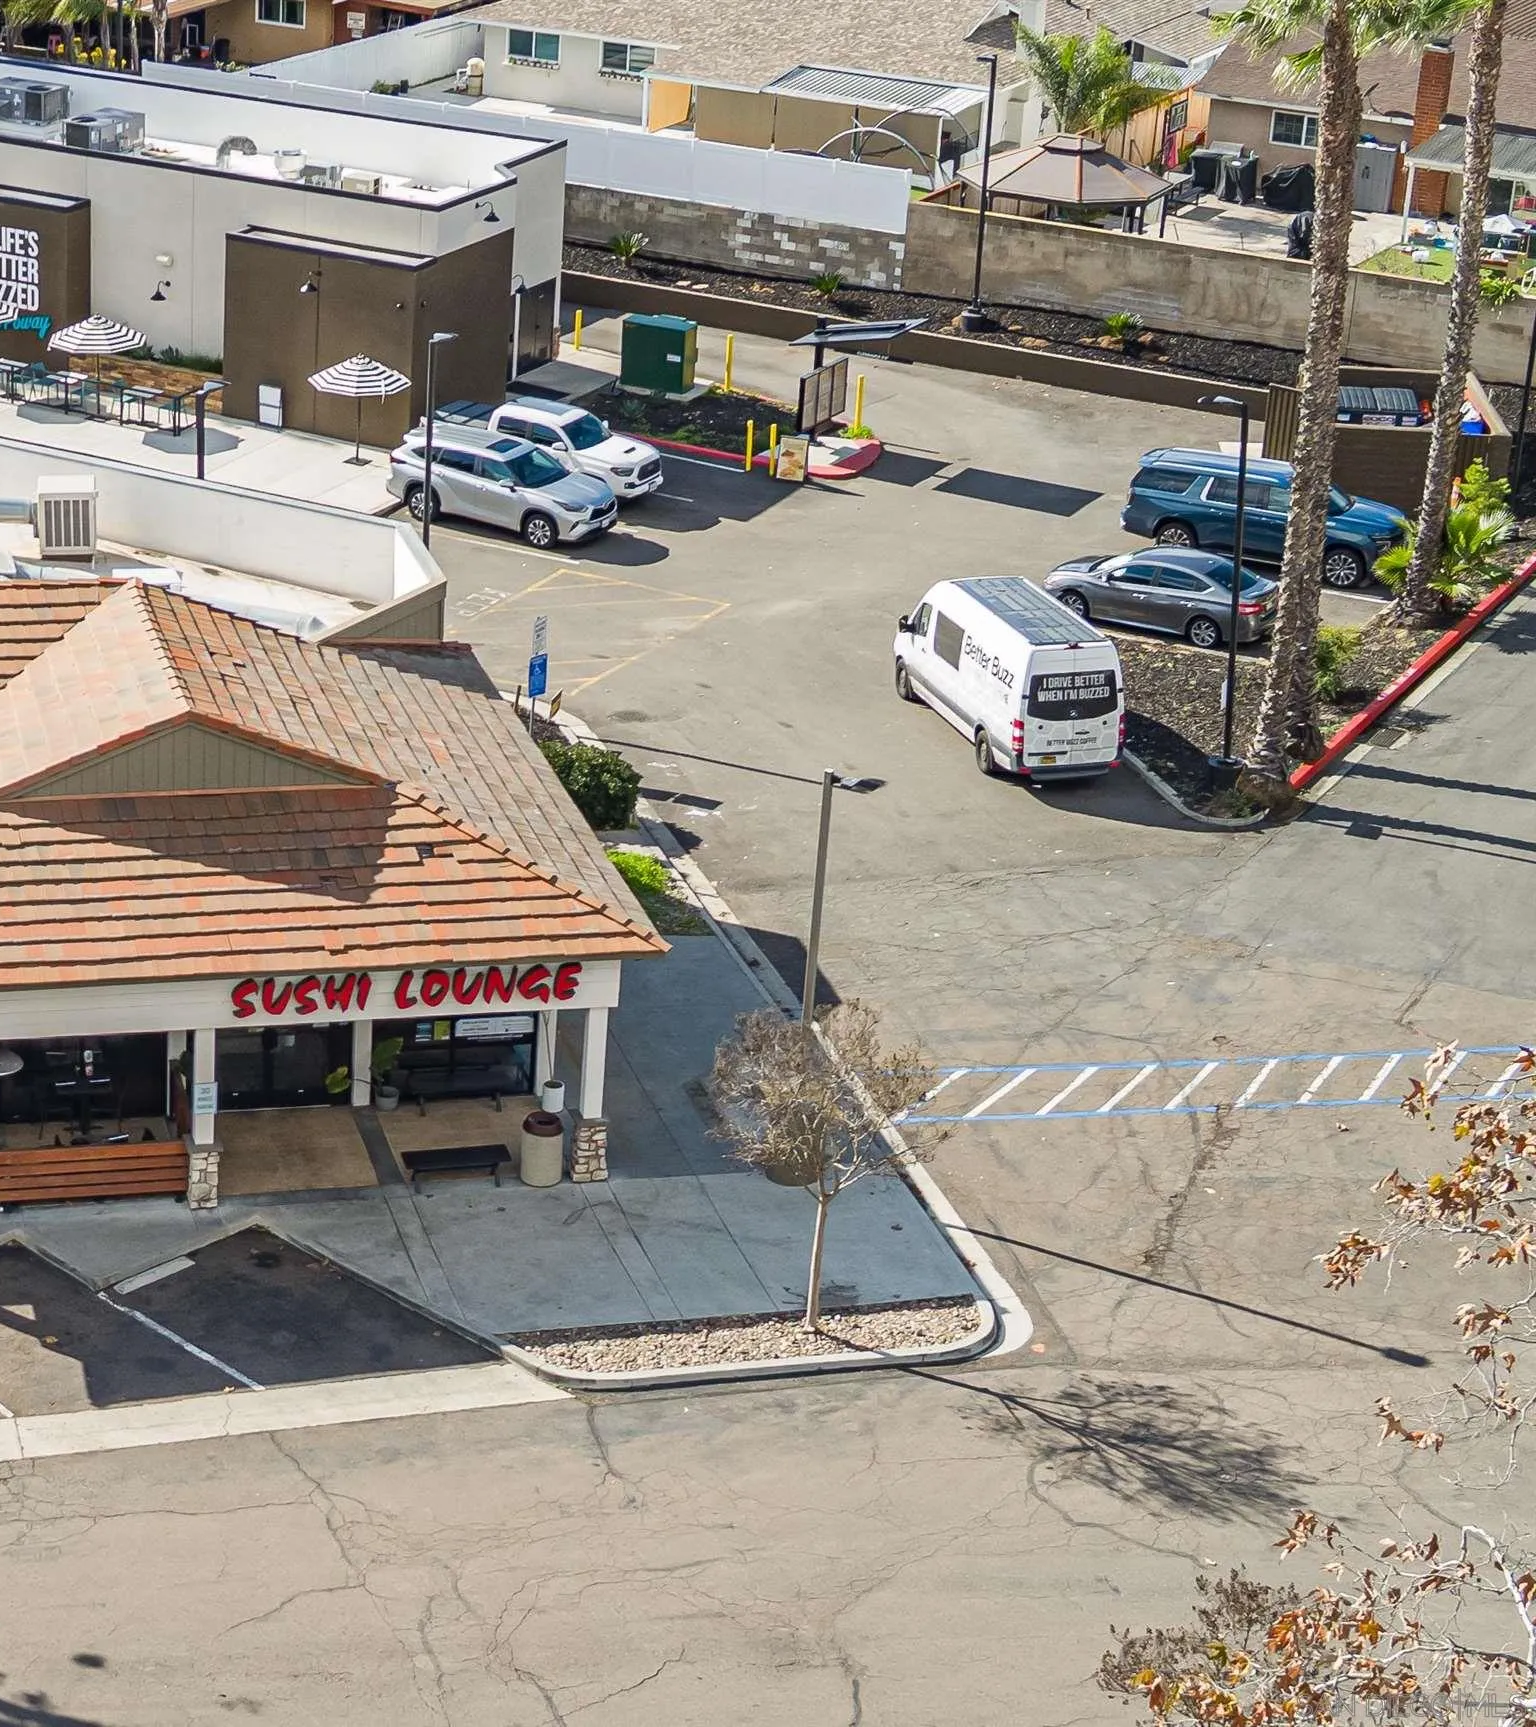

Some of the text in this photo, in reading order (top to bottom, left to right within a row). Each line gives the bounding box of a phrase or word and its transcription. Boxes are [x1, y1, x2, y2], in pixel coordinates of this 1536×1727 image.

[5, 315, 51, 339] oway
[964, 636, 1015, 689] Better Buzz
[1048, 676, 1073, 688] DRIVE
[1074, 674, 1105, 687] BETTER
[1037, 686, 1110, 702] WHEN I'M BUZZED
[231, 961, 583, 1019] SUSHI LOUNGE
